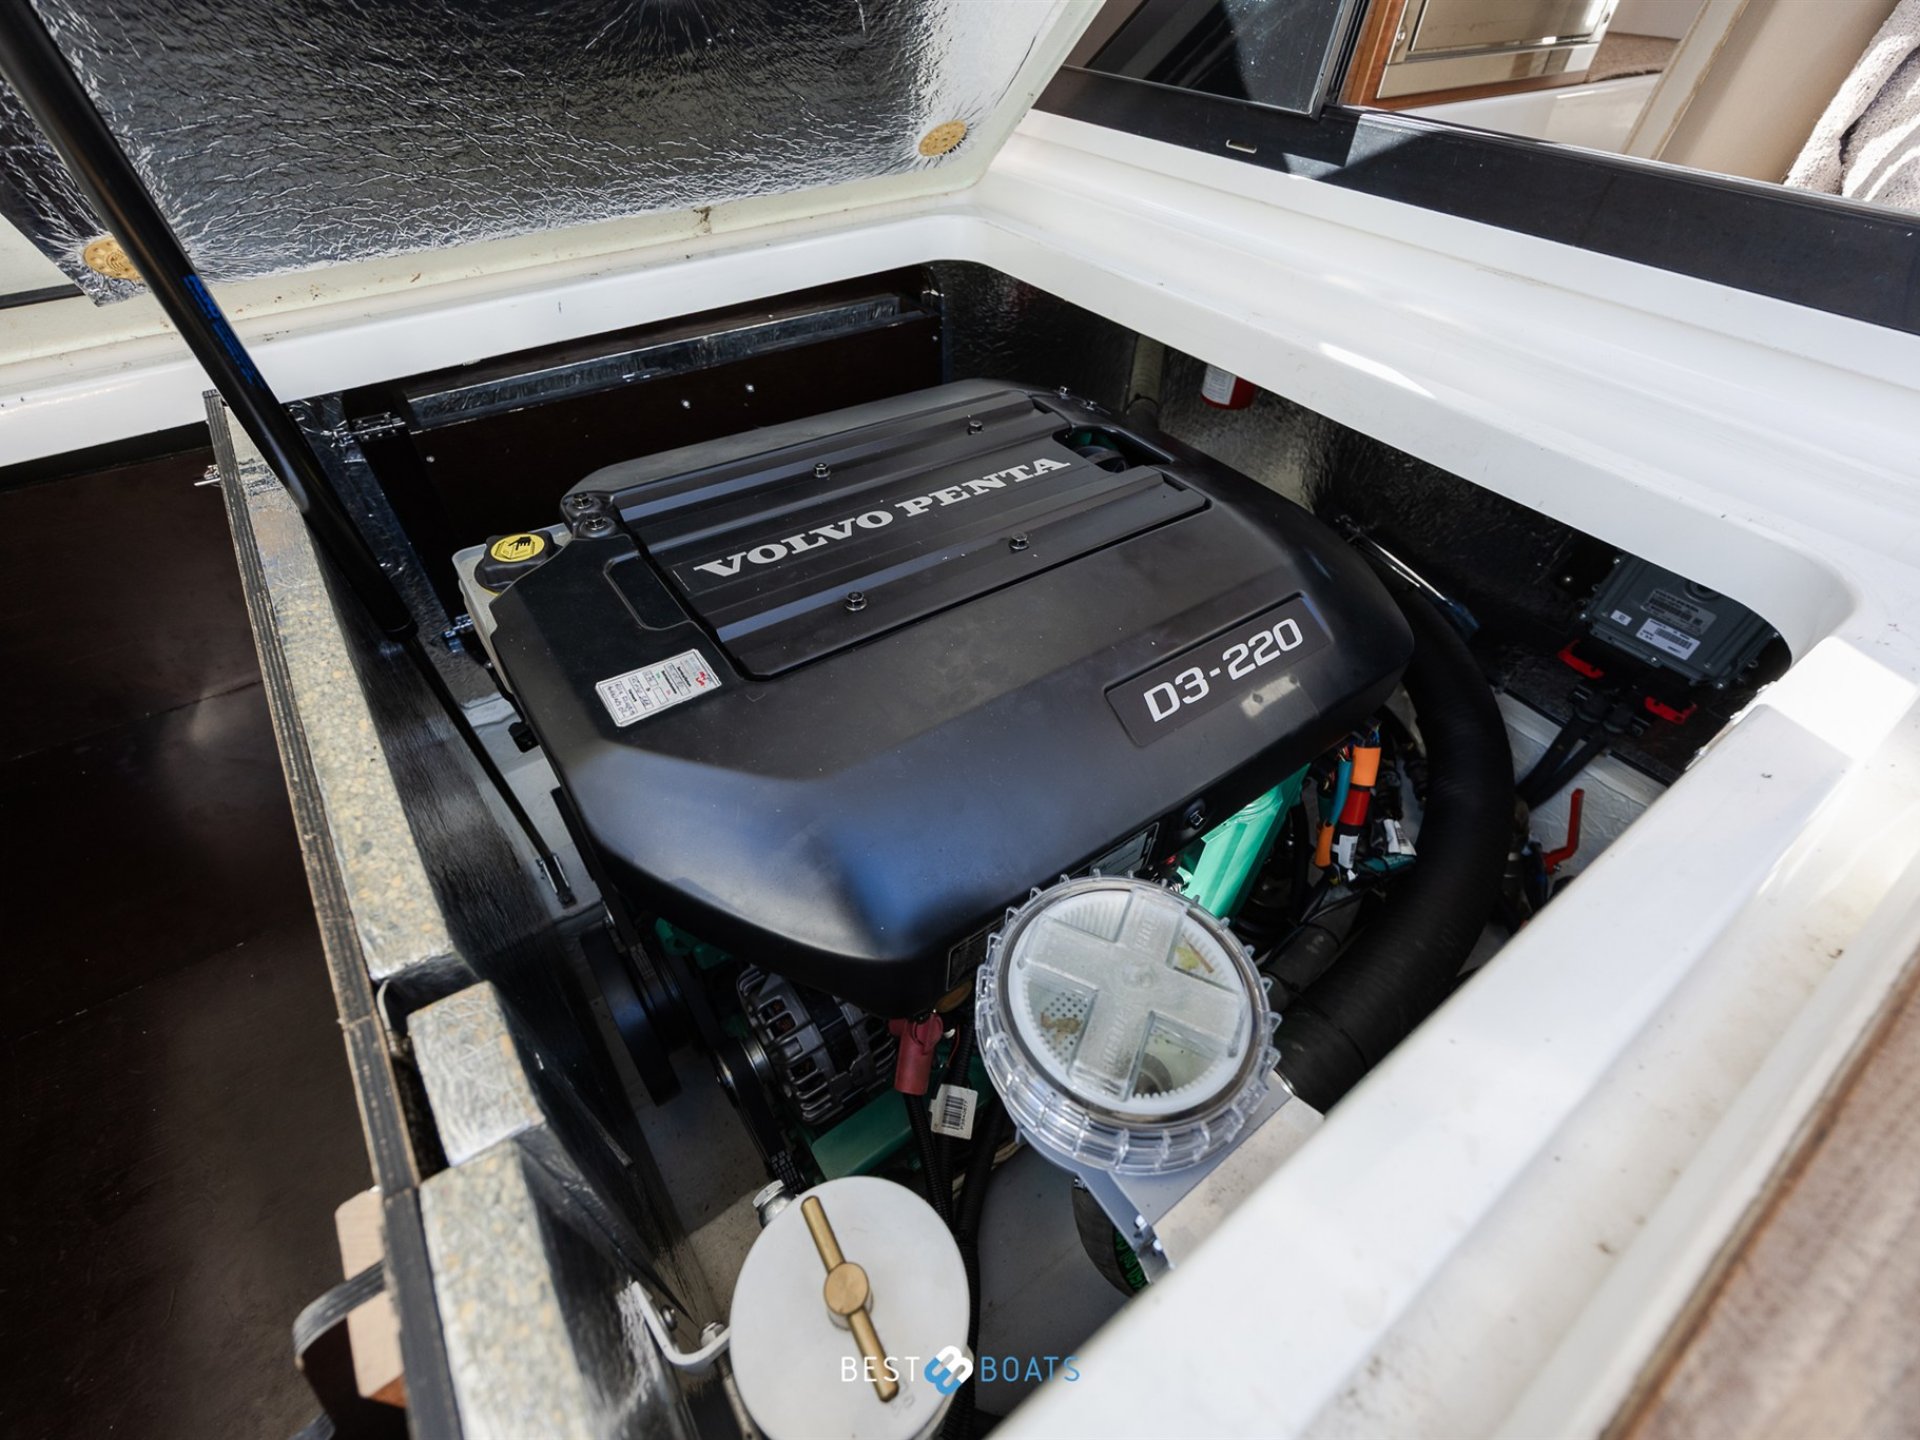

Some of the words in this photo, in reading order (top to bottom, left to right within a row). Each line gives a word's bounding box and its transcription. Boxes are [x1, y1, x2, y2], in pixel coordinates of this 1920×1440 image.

[693, 510, 894, 578] VOLVO
[895, 456, 1071, 517] PENTA
[1143, 618, 1304, 723] D3-220
